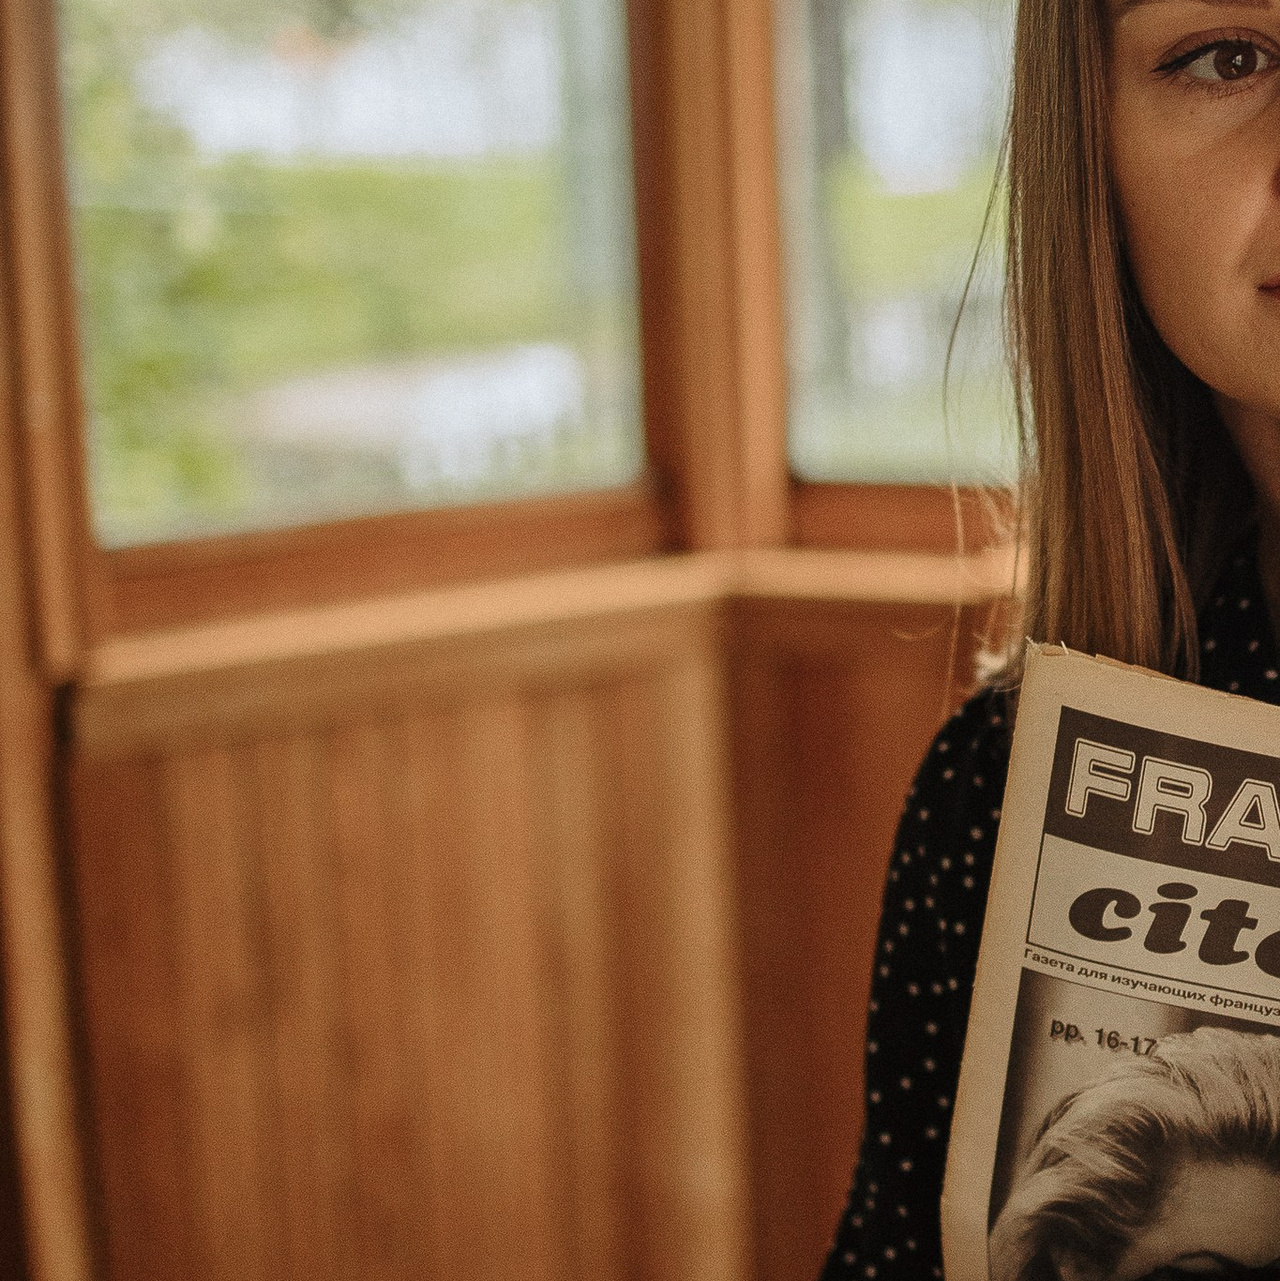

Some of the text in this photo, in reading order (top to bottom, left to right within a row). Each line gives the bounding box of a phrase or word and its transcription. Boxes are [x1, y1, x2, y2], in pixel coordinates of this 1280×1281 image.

[1023, 948, 1075, 973] Газета
[1077, 964, 1108, 982] для
[1111, 972, 1207, 1003] изучающих
[1050, 1019, 1158, 1057] pp. 16-17
